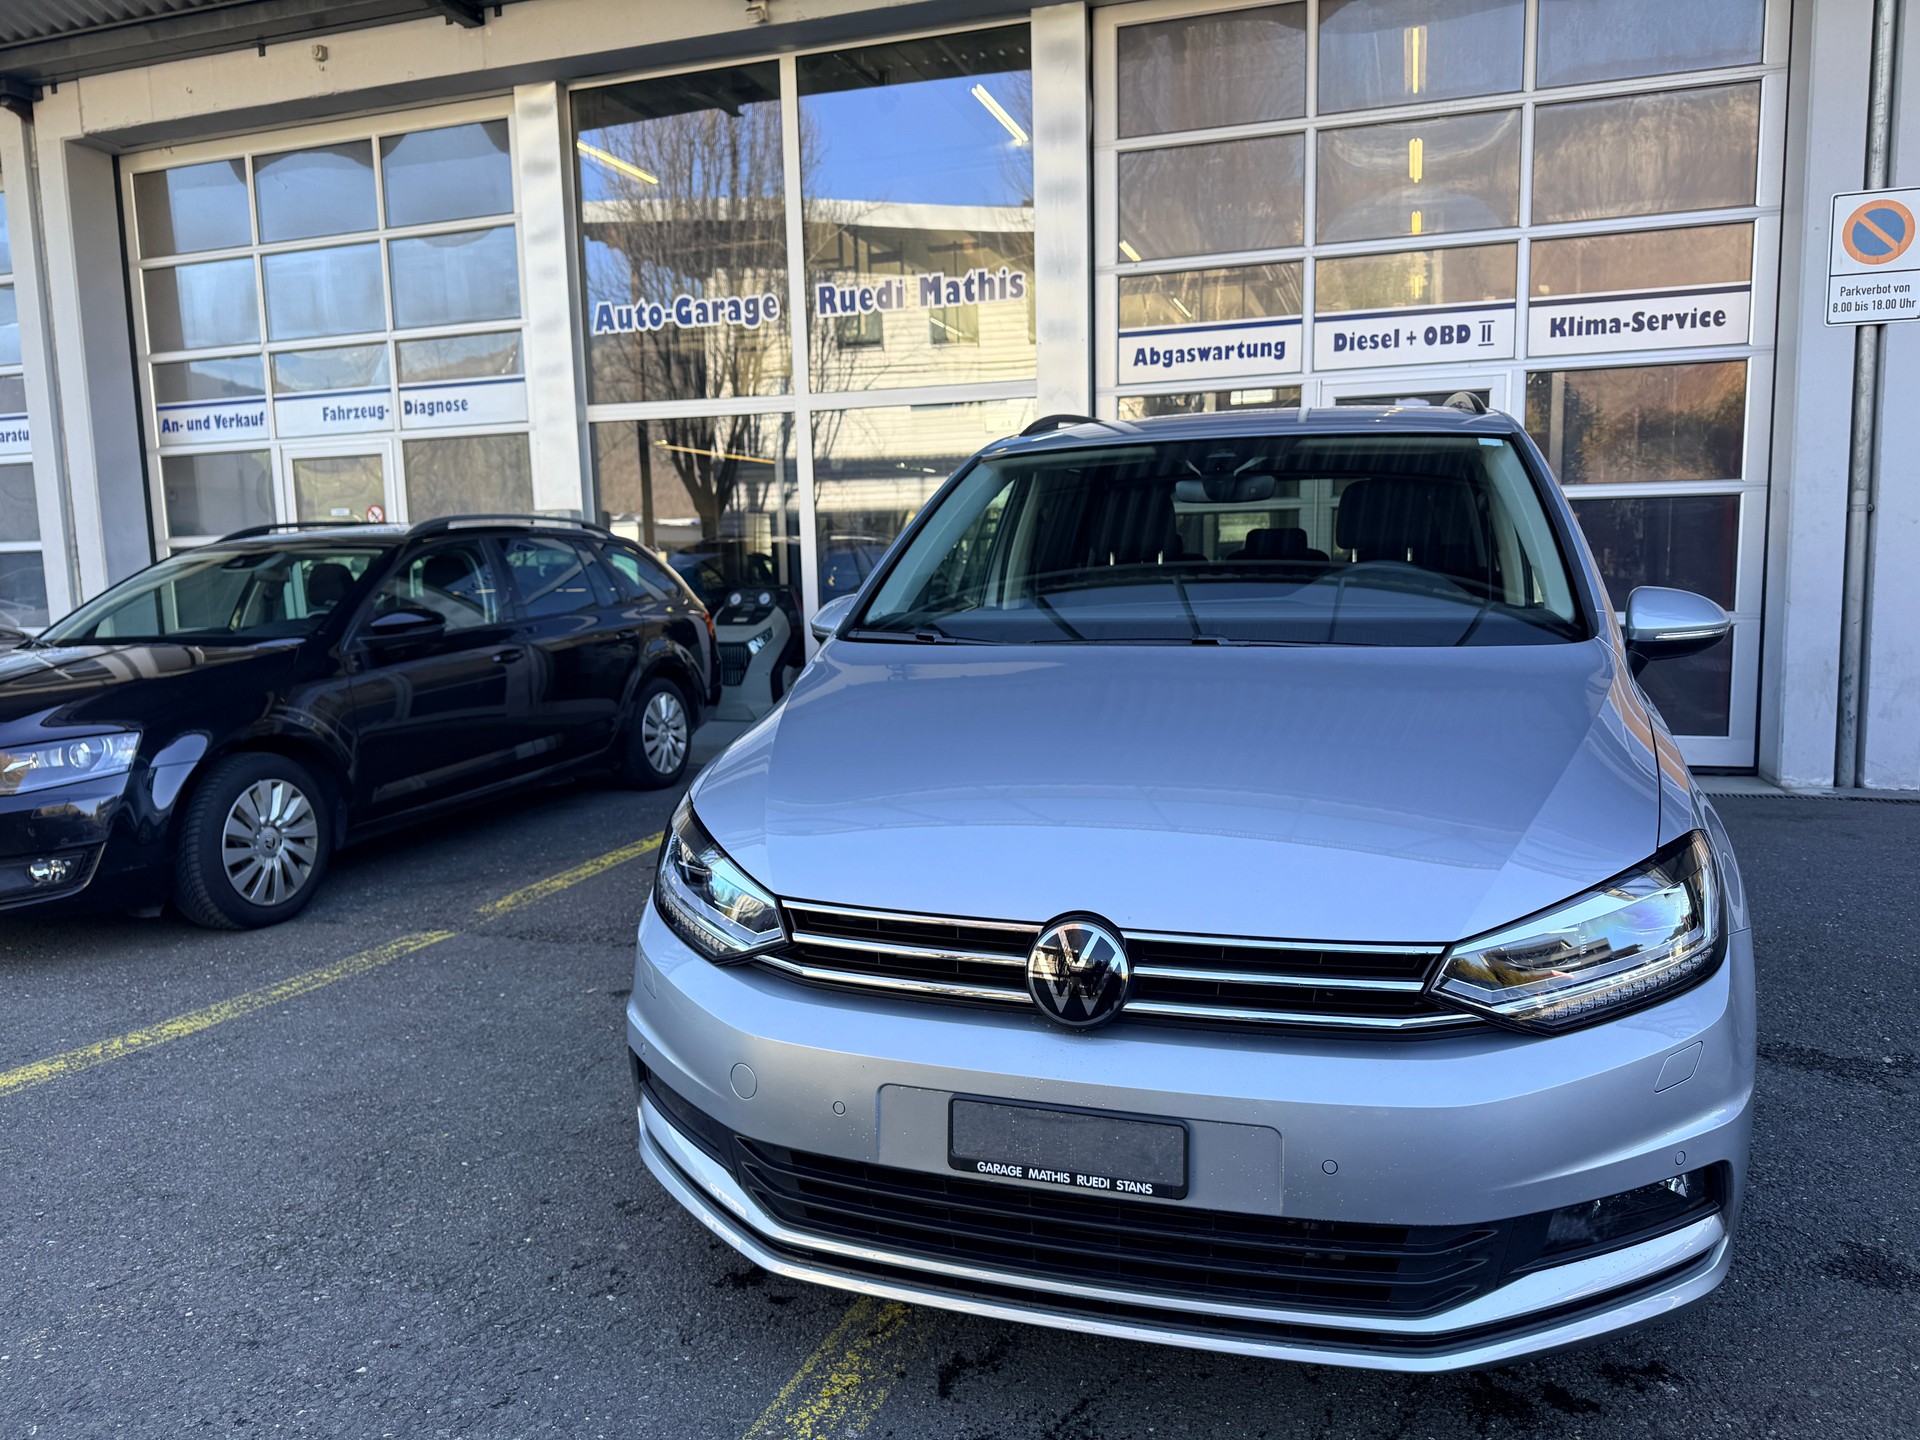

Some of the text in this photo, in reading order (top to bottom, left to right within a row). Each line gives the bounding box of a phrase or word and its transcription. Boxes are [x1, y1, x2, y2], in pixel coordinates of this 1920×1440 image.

[594, 267, 1025, 333] Auto-Garage Ruedi Mathis
[1839, 284, 1911, 297] Parkverbot von
[1832, 298, 1917, 313] 8.00 bis 18.00 Uhr
[1549, 307, 1727, 339] Klima-Service
[1333, 328, 1400, 352] Diesel
[1406, 331, 1417, 346] +
[1424, 324, 1471, 346] OBD
[1133, 340, 1286, 368] Abgaswartung
[161, 411, 265, 433] An- und Verkauf
[322, 398, 469, 422] Fahrzeug- Diagnose
[976, 1161, 1153, 1195] GARAGE MATHIS RUEDI STANS
